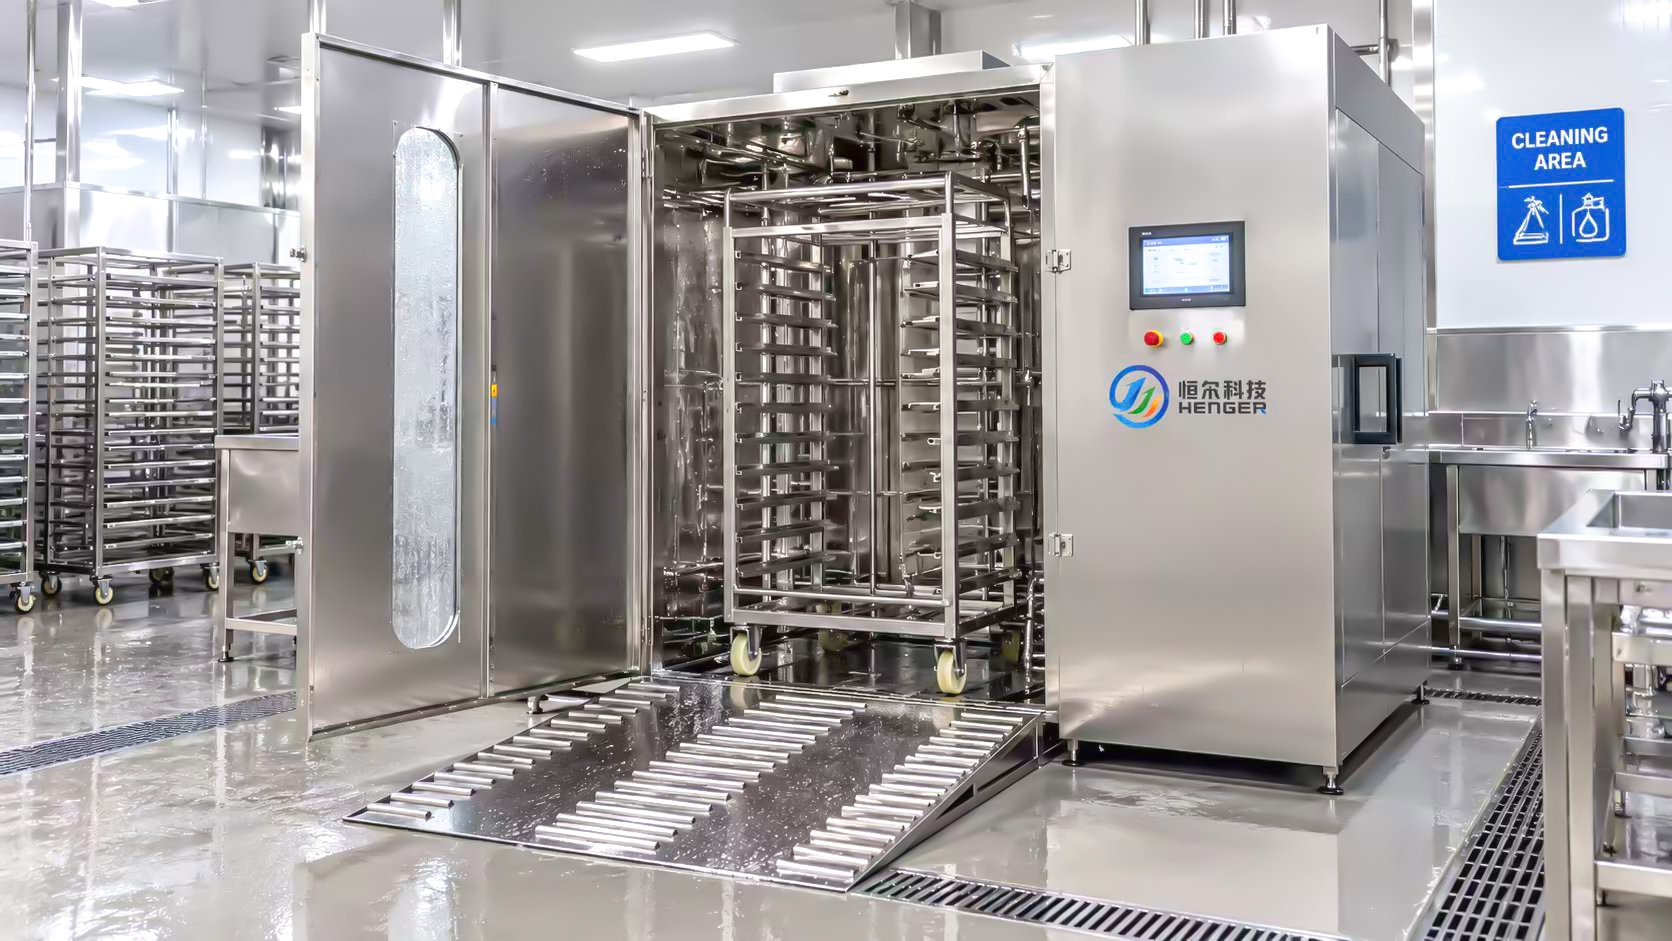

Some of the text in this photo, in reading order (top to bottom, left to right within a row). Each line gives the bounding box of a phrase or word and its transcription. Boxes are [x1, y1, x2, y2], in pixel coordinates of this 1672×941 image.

[1511, 127, 1609, 149] CLEANING
[1534, 151, 1587, 171] AREA
[1178, 380, 1267, 400] 恒尔科技
[1178, 402, 1267, 414] HENGER
